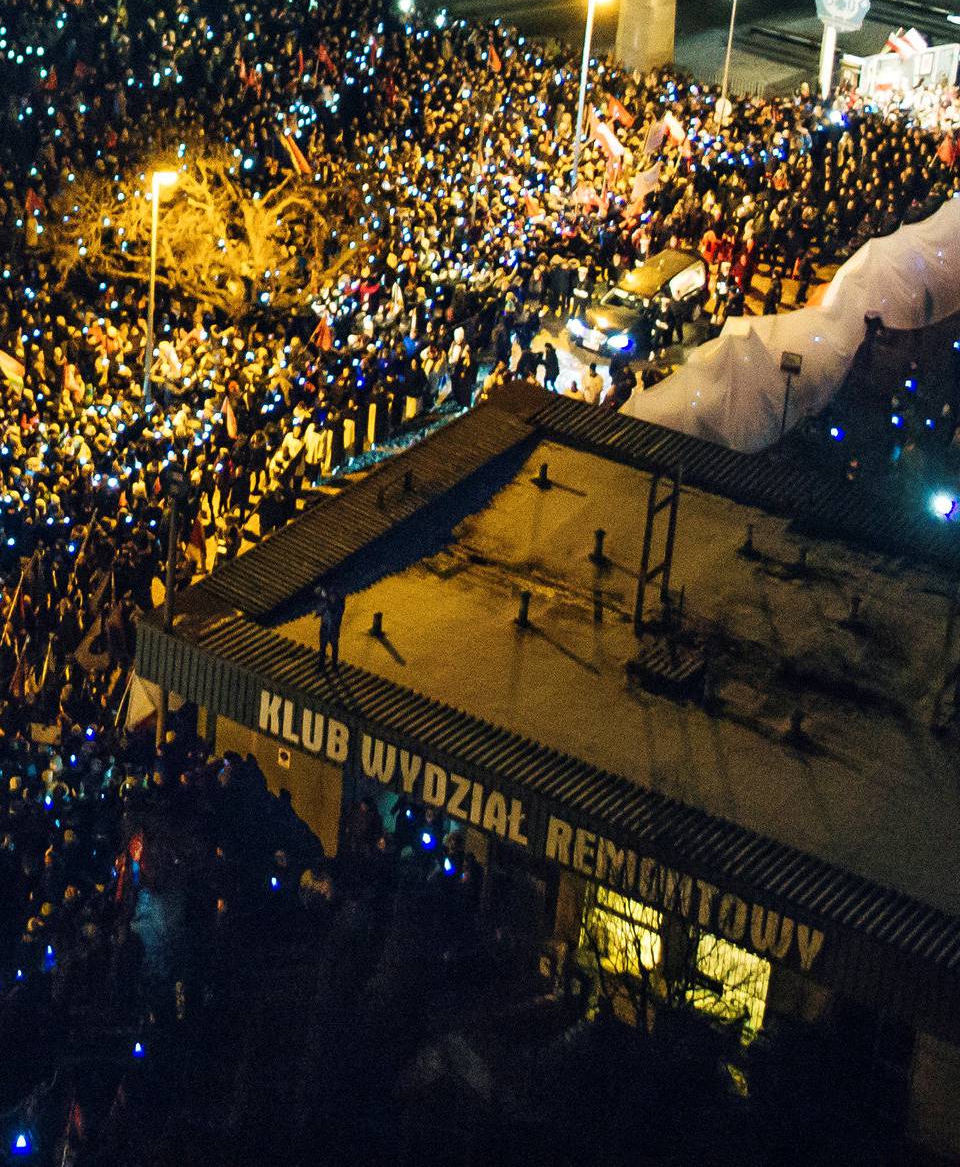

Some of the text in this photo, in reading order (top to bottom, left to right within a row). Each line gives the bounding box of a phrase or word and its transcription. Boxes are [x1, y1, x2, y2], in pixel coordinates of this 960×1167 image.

[258, 689, 826, 971] KLUB WYDZIAŁ REMONTOWY
